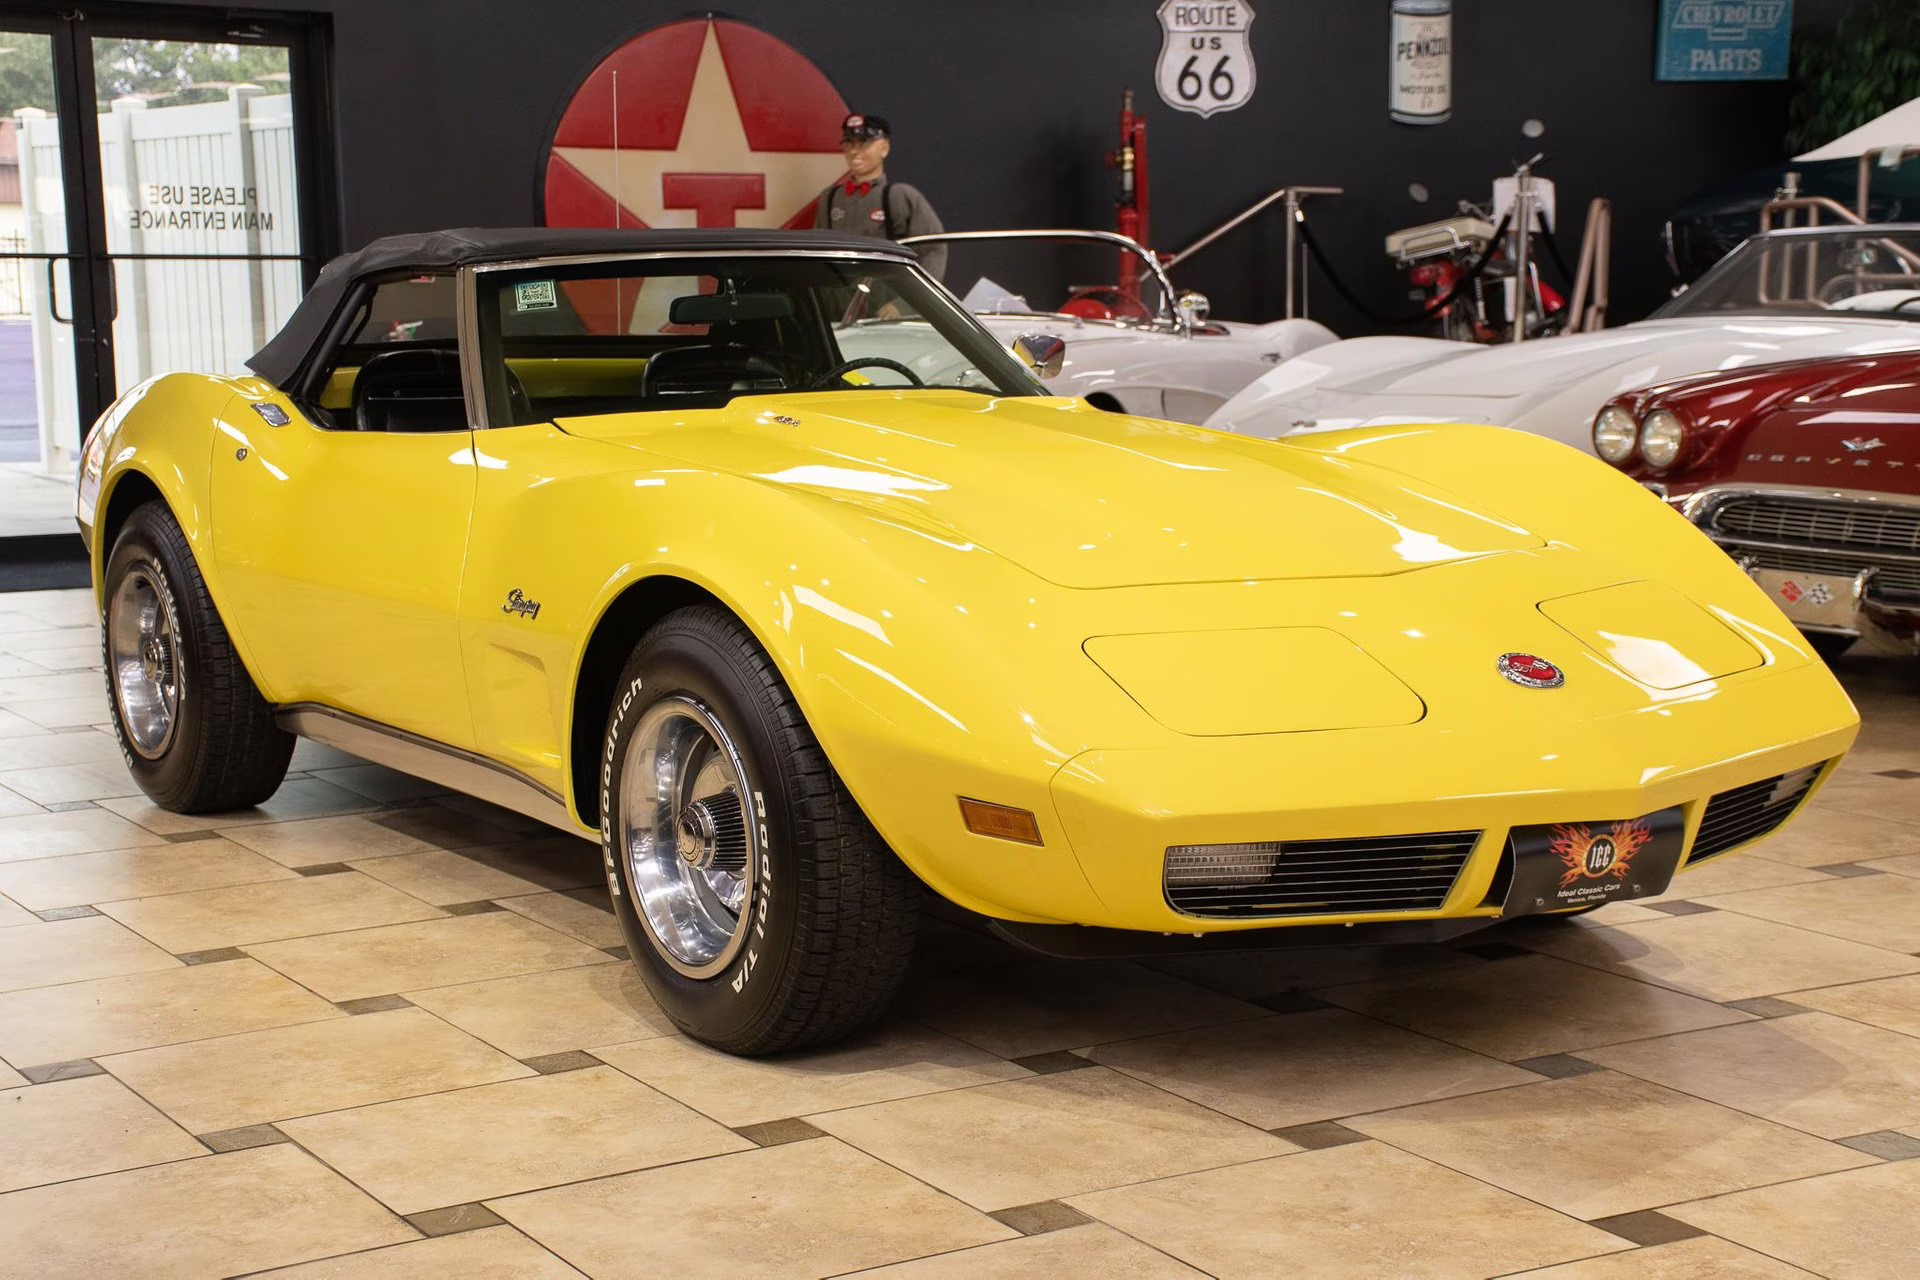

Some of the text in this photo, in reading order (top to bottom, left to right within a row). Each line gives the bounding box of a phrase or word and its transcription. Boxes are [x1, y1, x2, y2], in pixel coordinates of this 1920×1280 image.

[1175, 6, 1236, 26] ROUTE
[1682, 4, 1780, 24] CHEVROLET
[1191, 37, 1222, 50] US
[1689, 48, 1762, 72] PARTS
[1178, 55, 1234, 101] 66
[602, 676, 643, 896] BFGoodrich
[754, 790, 772, 940] Radial
[1557, 889, 1577, 898] Ideal
[1577, 886, 1603, 895] Classic
